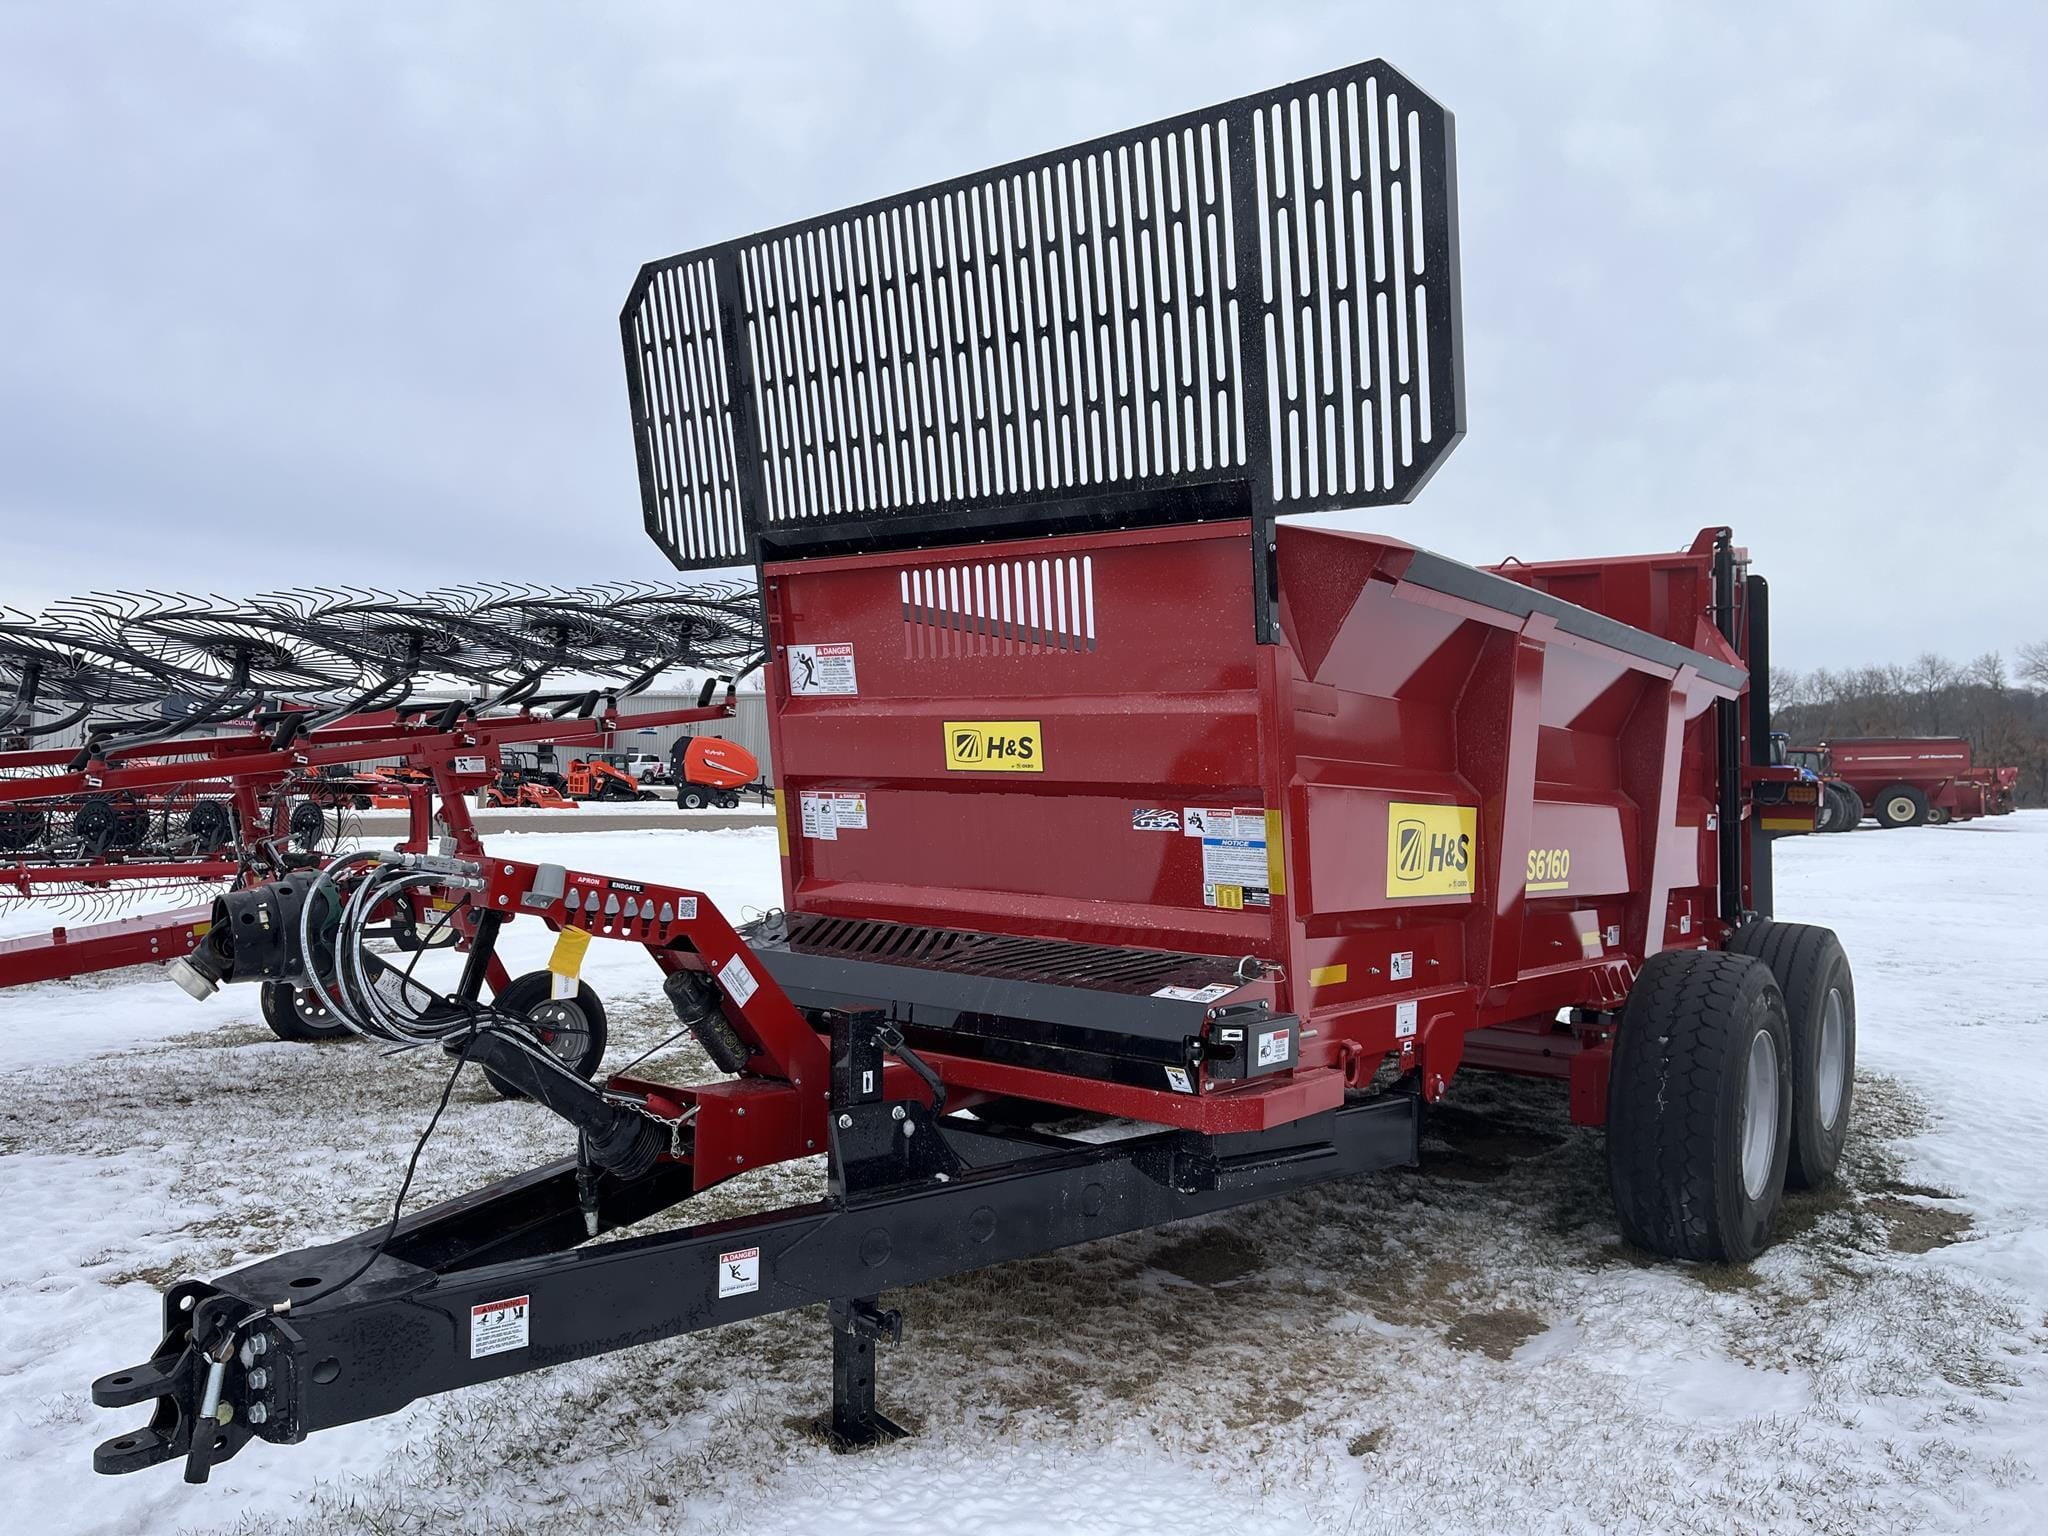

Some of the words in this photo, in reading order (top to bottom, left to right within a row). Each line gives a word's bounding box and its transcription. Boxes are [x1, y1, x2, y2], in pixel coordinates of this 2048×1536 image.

[823, 646, 851, 655] DANGER
[987, 736, 1033, 760] H&S
[1428, 834, 1469, 872] H&S
[1526, 849, 1570, 880] S6160
[578, 876, 600, 885] APRON
[612, 882, 640, 892] ENDGATE
[730, 1250, 757, 1260] DANGER
[488, 1300, 520, 1310] WARNING
